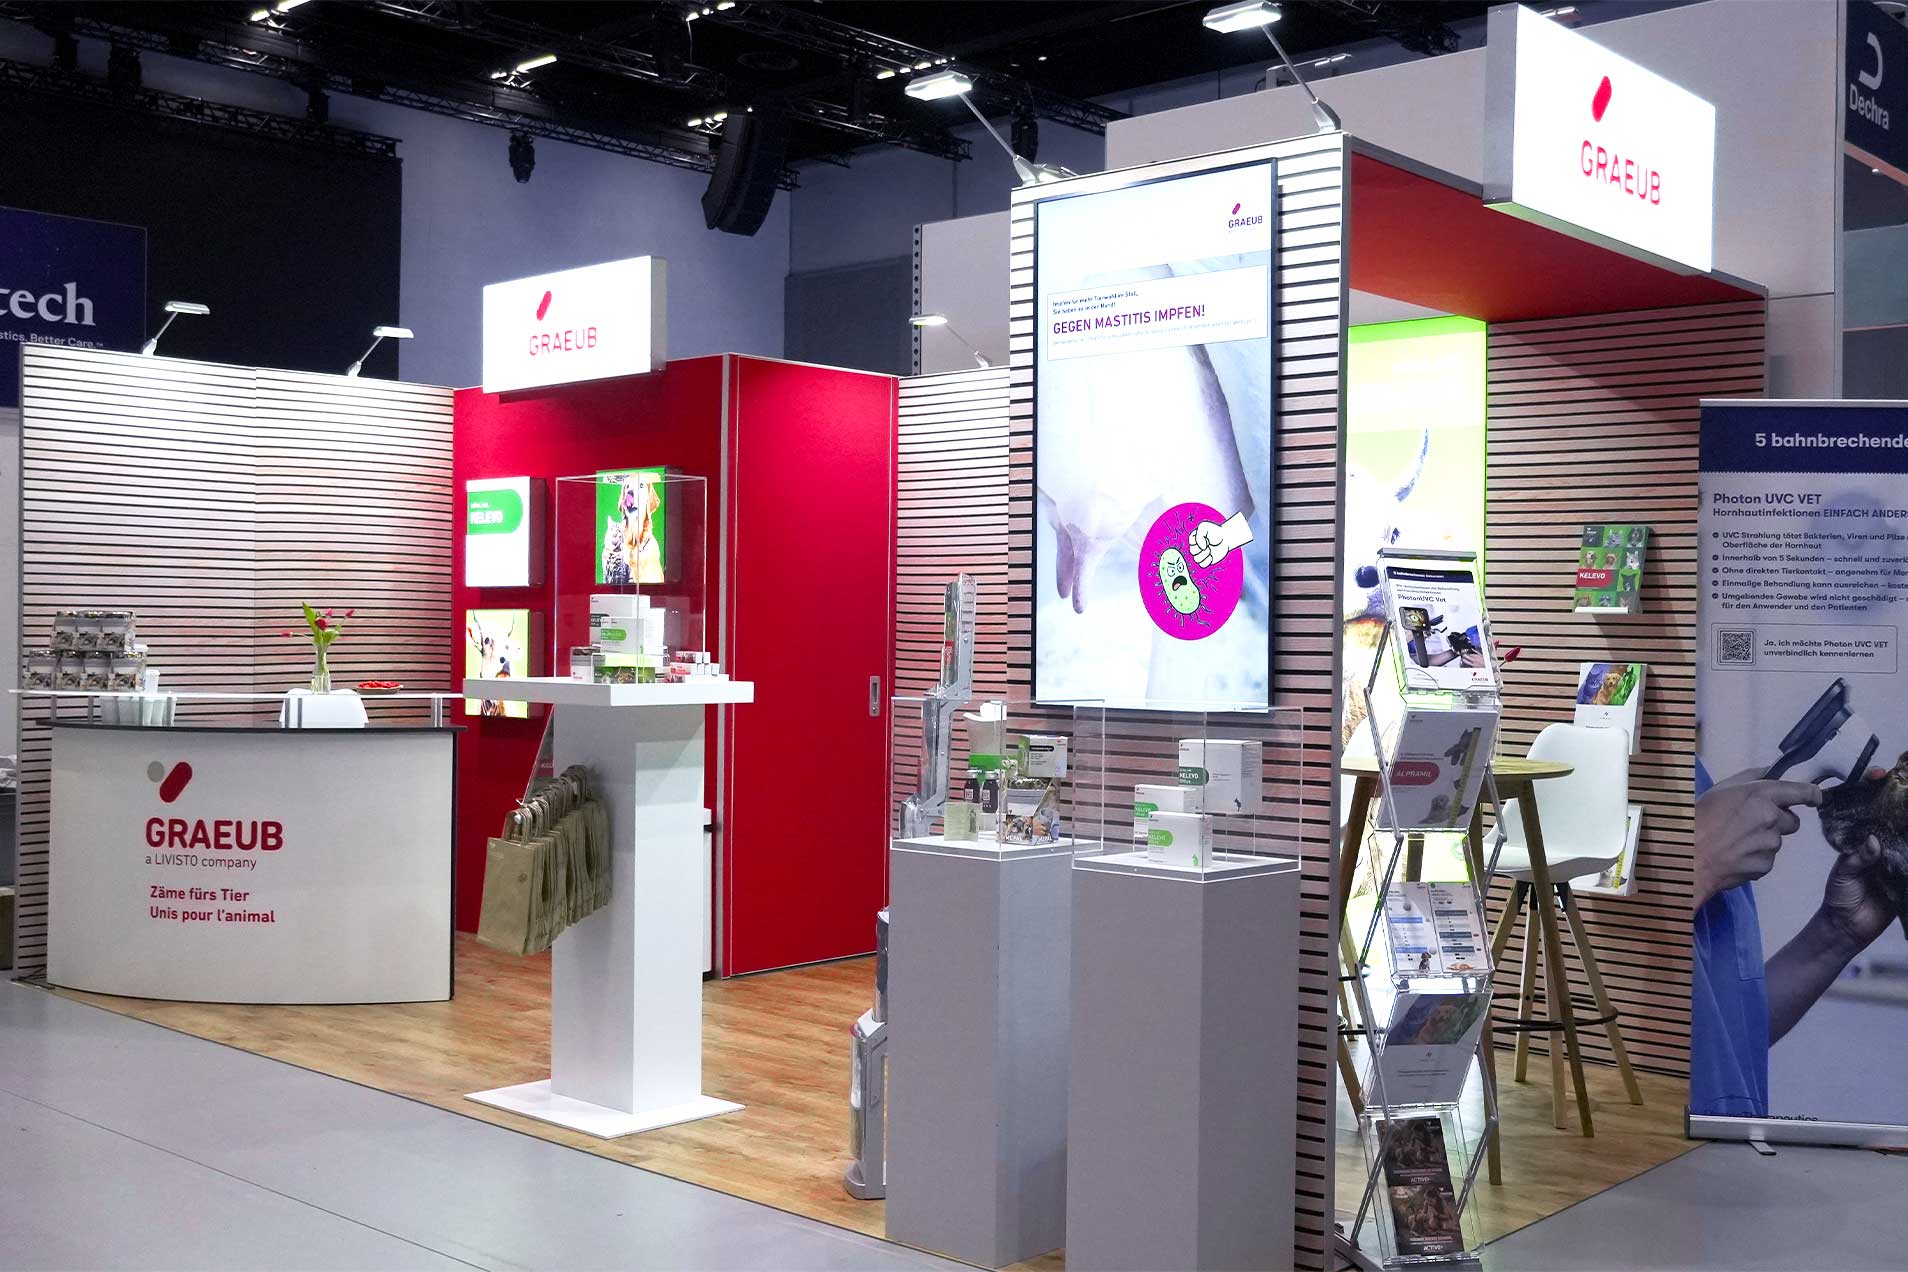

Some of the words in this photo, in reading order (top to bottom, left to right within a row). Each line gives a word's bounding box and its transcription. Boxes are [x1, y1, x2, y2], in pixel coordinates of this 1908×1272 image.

[1848, 83, 1890, 131] Dechra
[1581, 140, 1661, 206] GRAEUB
[1228, 216, 1263, 228] GRAEUB
[1054, 319, 1090, 334] GEGEN
[1096, 311, 1150, 329] MASTITIS
[1154, 304, 1205, 322] IMPFEN!
[30, 333, 65, 345] Better
[529, 326, 598, 356] GRAEUB
[1755, 433, 1766, 447] 5
[1714, 493, 1761, 504] Photon
[1765, 493, 1794, 504] UVC
[1797, 494, 1822, 504] VET
[1713, 508, 1820, 518] Hornhautinfektionen
[1824, 509, 1869, 518] EINFACH
[1872, 510, 1908, 518] ANDER
[1741, 532, 1780, 540] Strahlung
[1722, 580, 1761, 588] Einmalige
[1764, 580, 1810, 589] Behandlung
[1752, 602, 1792, 610] Anwender
[1820, 650, 1874, 658] kennenlernen
[146, 818, 283, 850] GRAEUB
[146, 856, 151, 864] a
[155, 854, 198, 866] LIVISTO
[202, 857, 256, 871] company
[150, 886, 185, 899] Zäme
[189, 887, 216, 900] fürs
[221, 889, 249, 901] Tier
[150, 907, 178, 920] Unis
[182, 910, 213, 924] pour
[217, 908, 275, 923] l'animal
